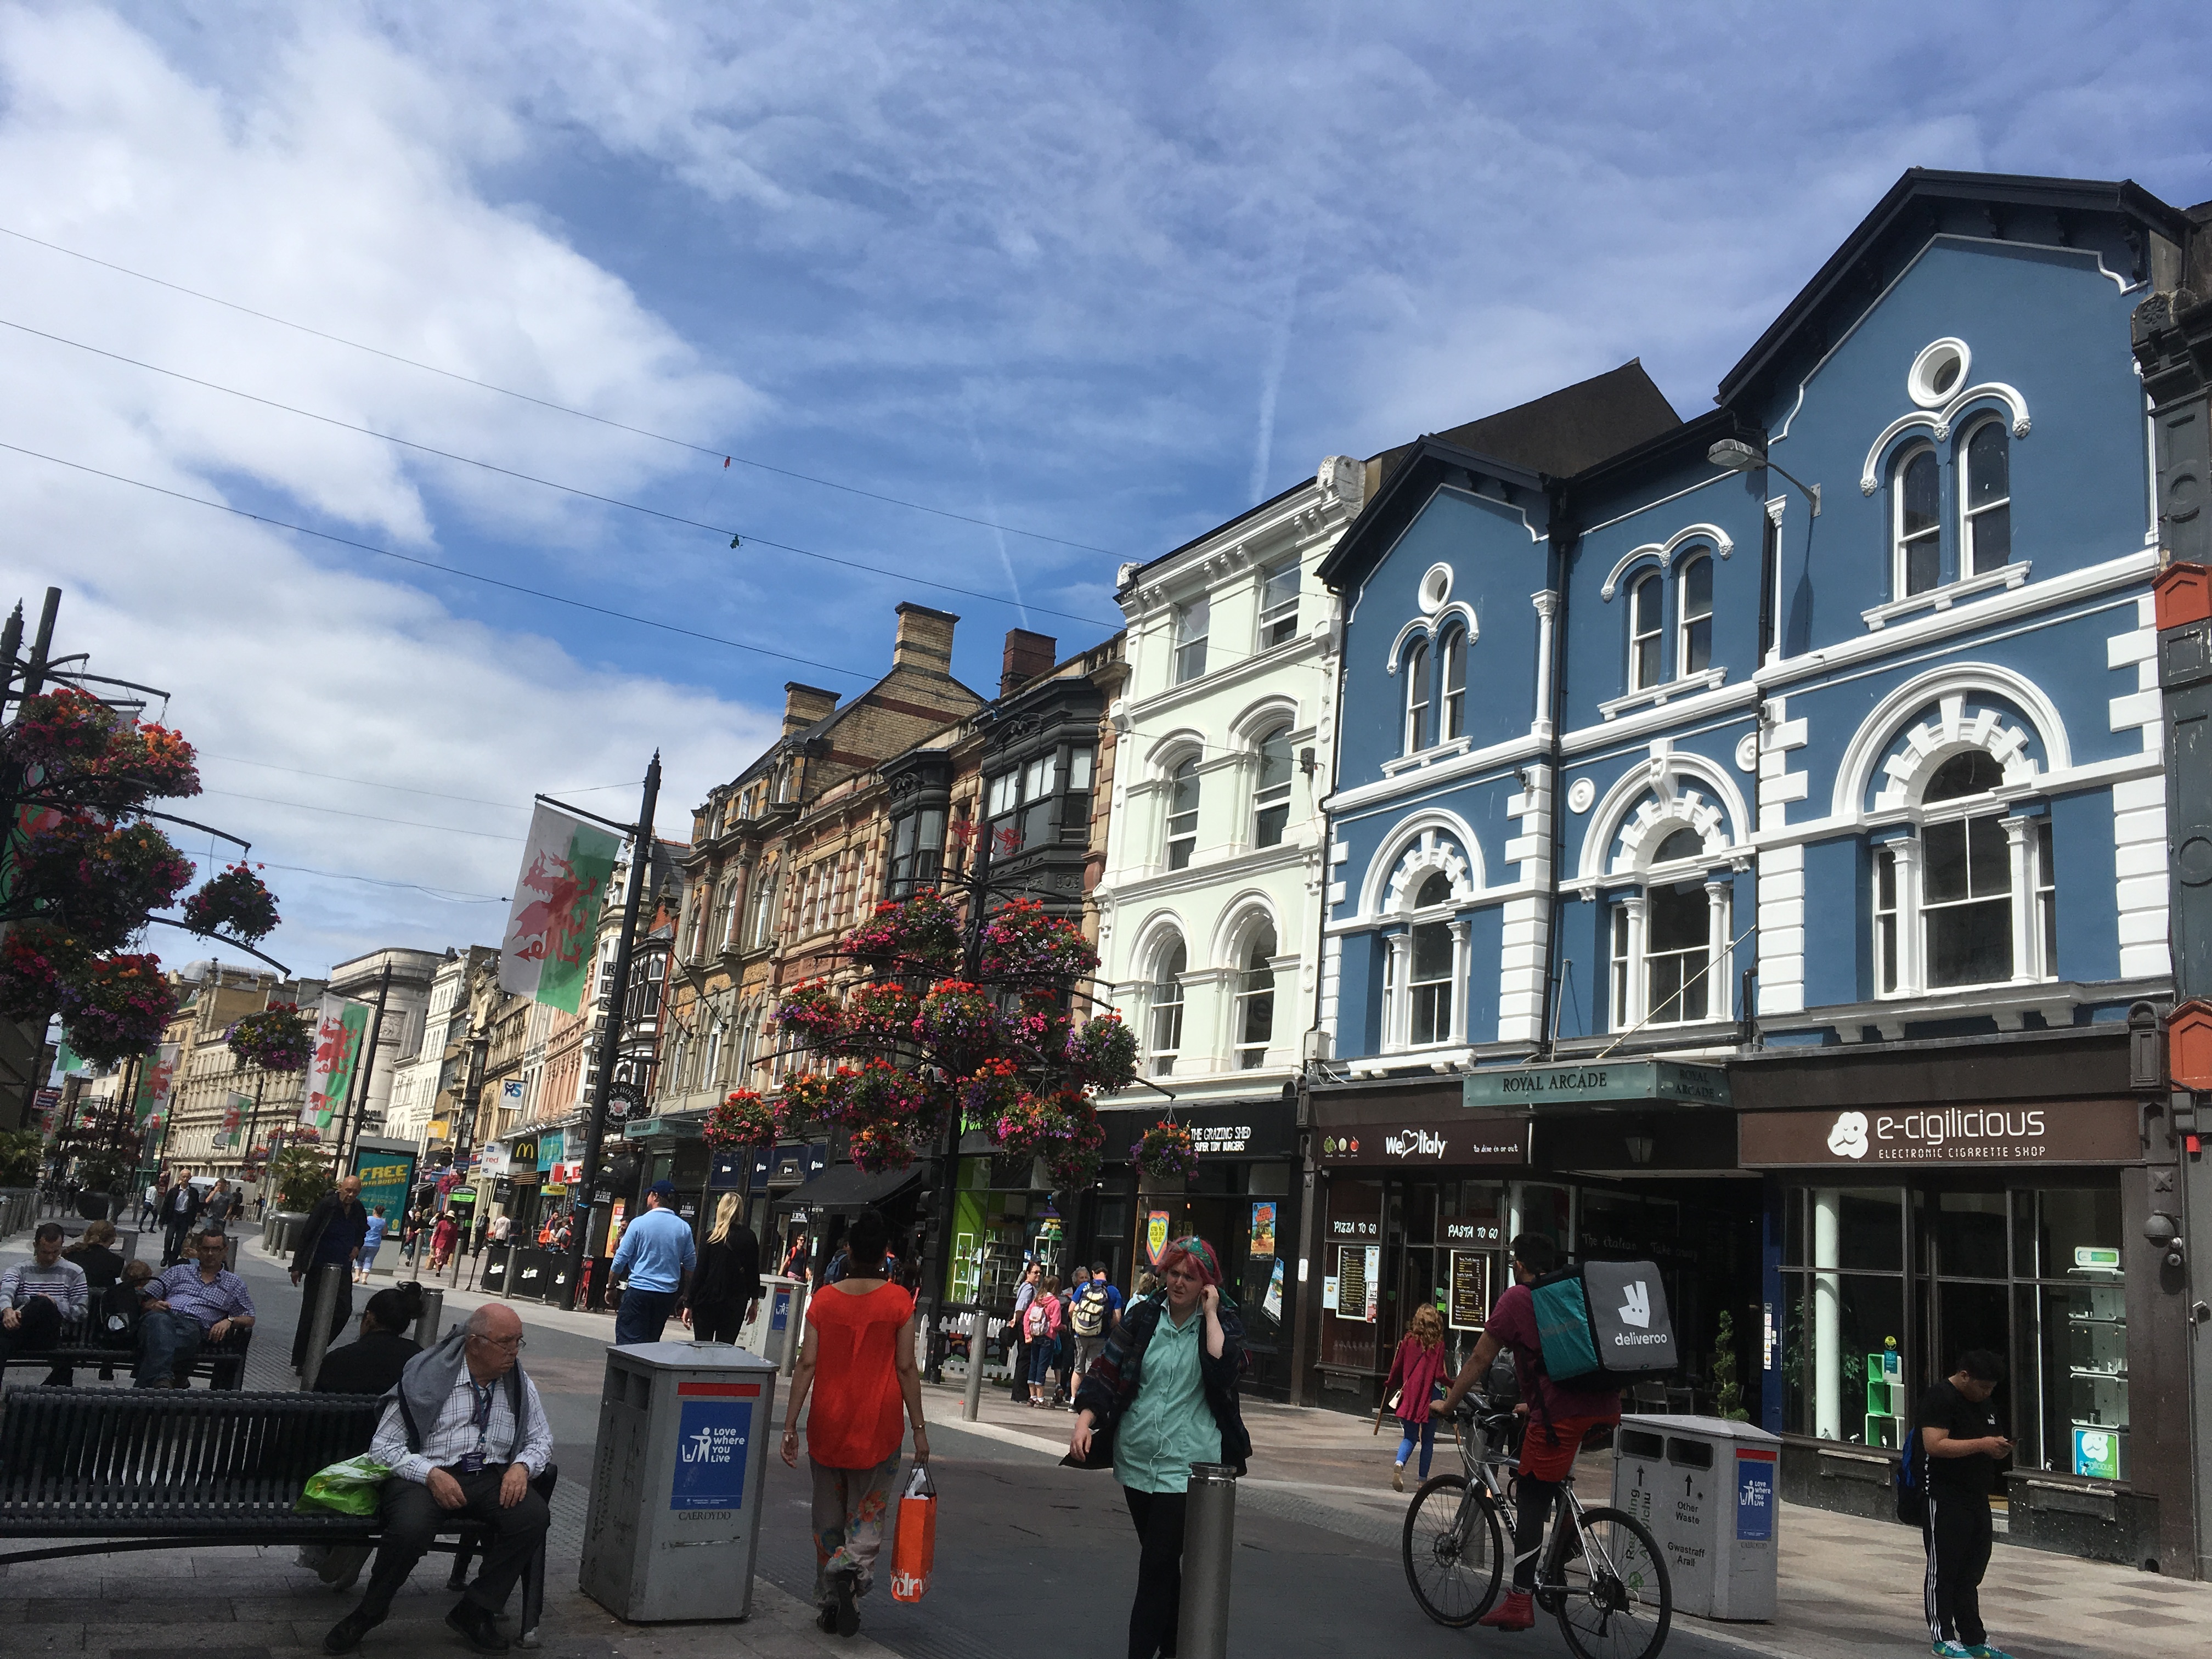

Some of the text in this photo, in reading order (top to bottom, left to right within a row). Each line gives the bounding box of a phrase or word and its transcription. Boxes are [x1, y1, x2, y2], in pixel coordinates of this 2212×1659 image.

[1502, 1073, 1607, 1092] ROYAL ARCADE
[1679, 1069, 1709, 1082] ROYAL
[619, 1086, 640, 1107] HOUSE
[1675, 1084, 1714, 1097] ARCADE
[1877, 1107, 2045, 1145] e-cigilicious
[1190, 1126, 1251, 1141] THE GRAZING SHED
[1194, 1141, 1245, 1152] SUPER TIDY BURGERS
[1386, 1136, 1404, 1154] We
[1473, 1144, 1480, 1153] to
[1481, 1144, 1492, 1153] dine
[1508, 1143, 1518, 1152] out
[1878, 1146, 2046, 1159] ELECTRONIC CIGARETTE SHOP
[359, 1164, 408, 1180] FREE
[1334, 1221, 1376, 1234] PIZZA TO GO
[1448, 1224, 1498, 1239] PASTA TO GO
[1582, 1233, 1598, 1247] The
[1650, 1242, 1672, 1255] Take
[1615, 1332, 1667, 1346] deliveroo
[713, 1435, 745, 1445] where
[1677, 1501, 1699, 1513] Other
[679, 1511, 731, 1521] CAERDYDD
[1675, 1511, 1701, 1525] Waste
[1626, 1488, 1640, 1560] Recling
[1668, 1542, 1705, 1558] Gwastraff
[1677, 1555, 1696, 1567] Arall
